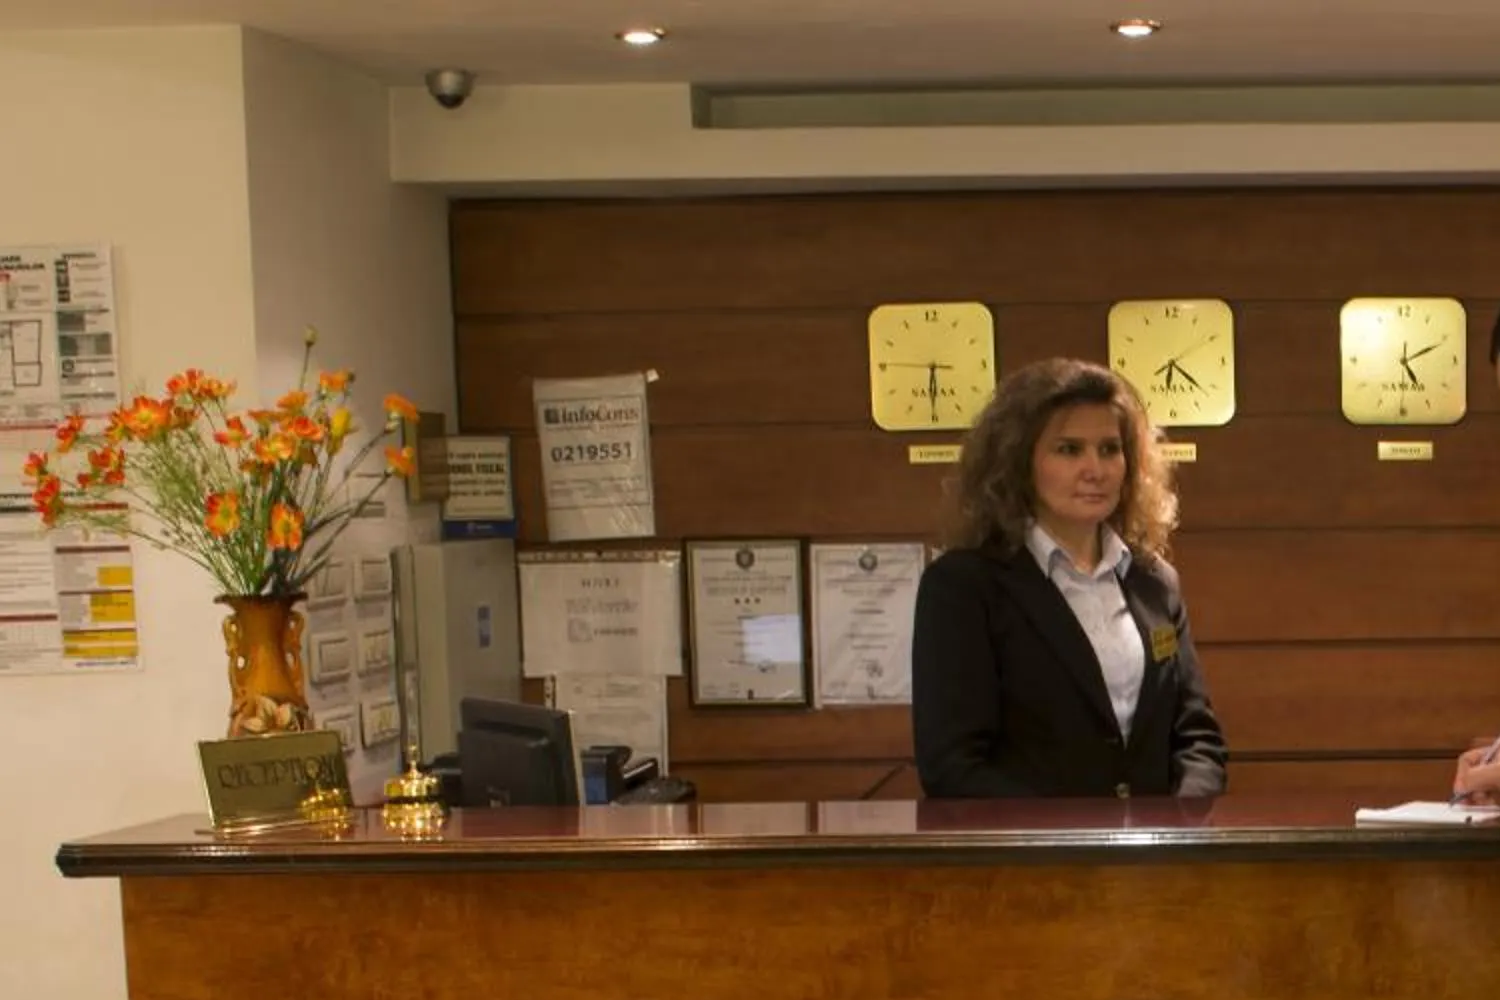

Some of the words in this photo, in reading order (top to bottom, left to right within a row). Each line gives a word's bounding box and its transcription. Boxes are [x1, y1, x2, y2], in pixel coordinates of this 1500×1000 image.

[912, 387, 956, 397] SAAA
[562, 404, 638, 424] InfoCons
[551, 441, 632, 463] 0219551
[217, 754, 338, 789] RECEPTION
